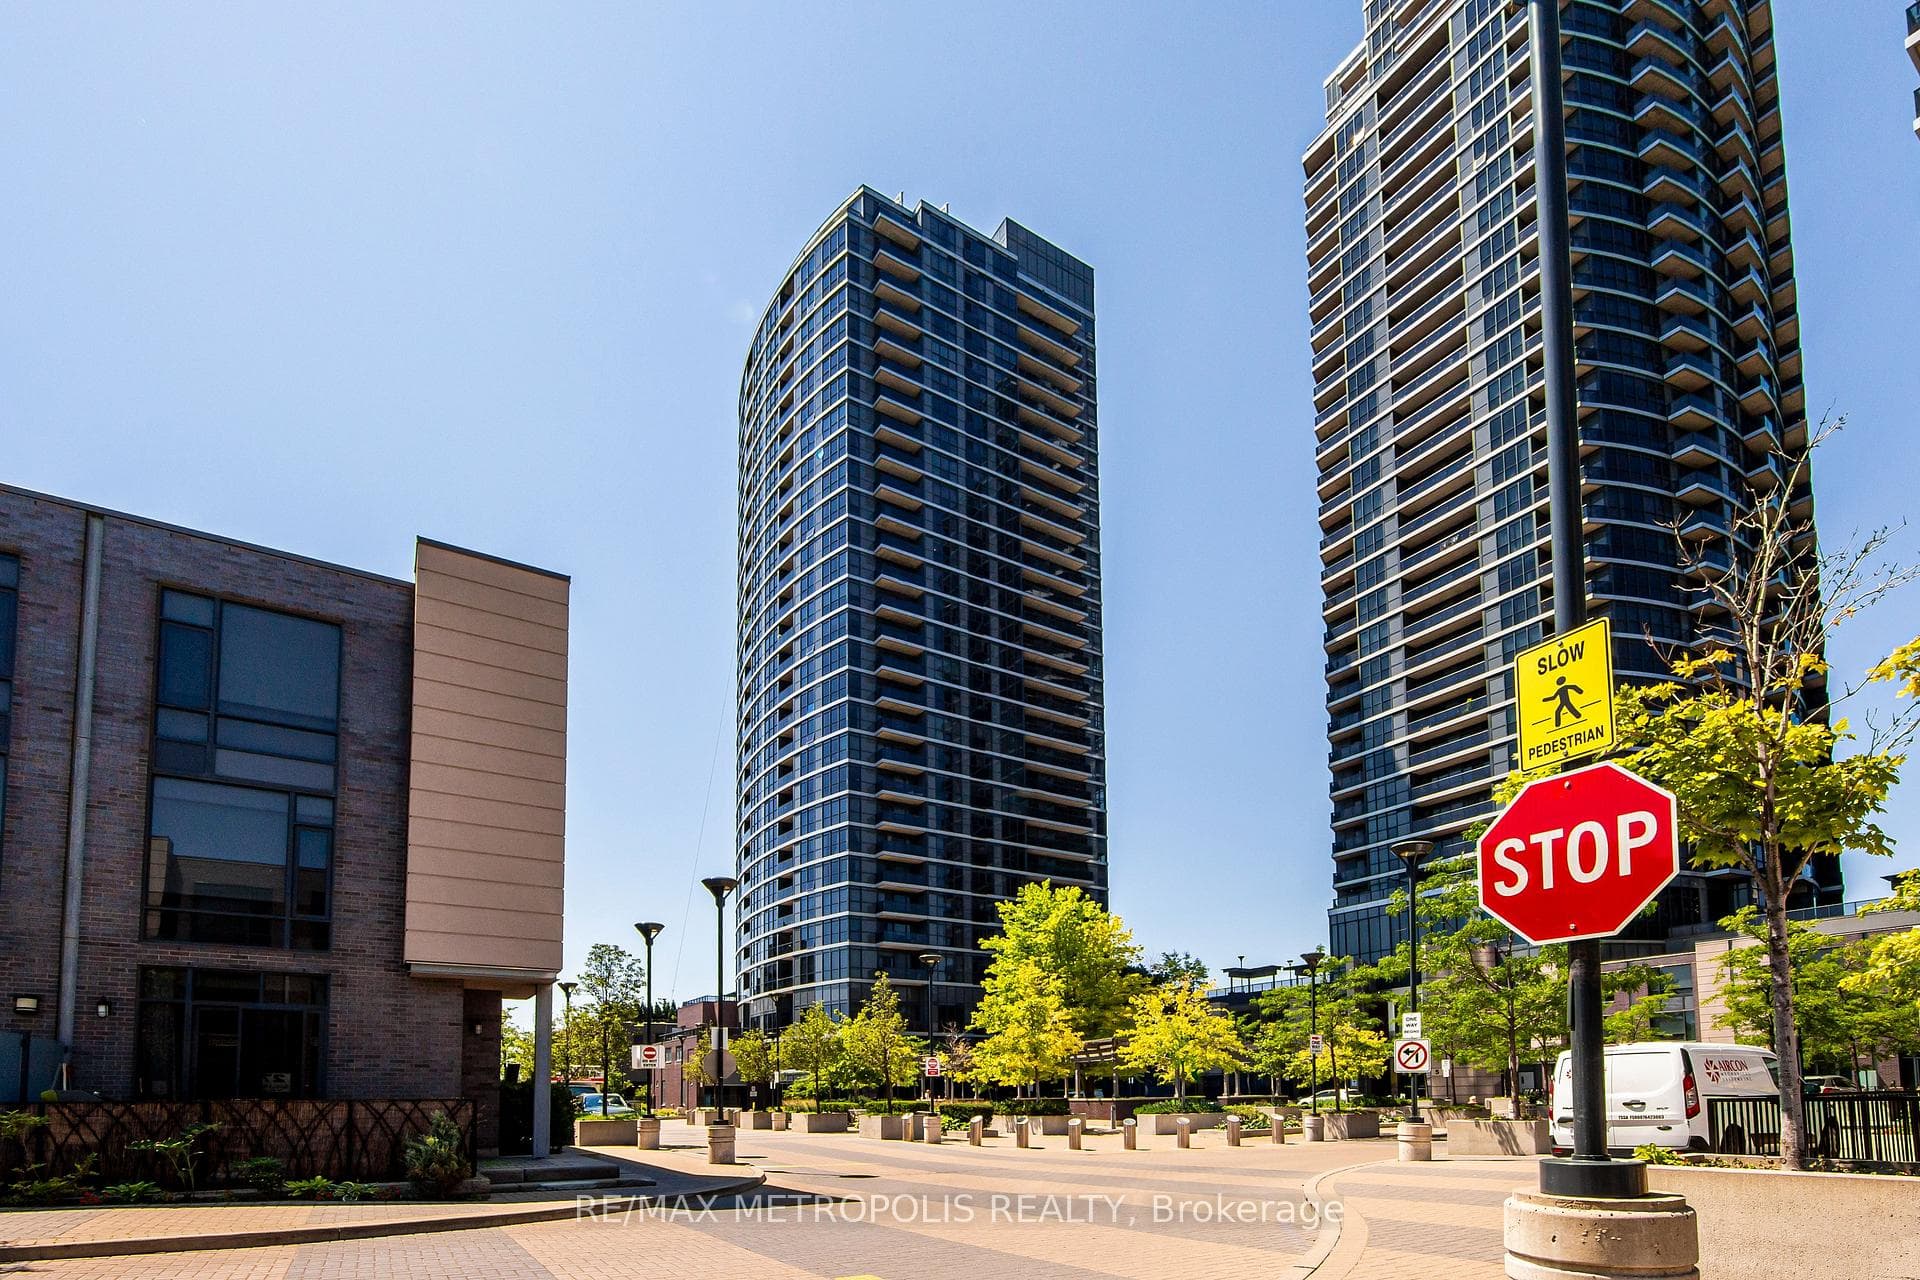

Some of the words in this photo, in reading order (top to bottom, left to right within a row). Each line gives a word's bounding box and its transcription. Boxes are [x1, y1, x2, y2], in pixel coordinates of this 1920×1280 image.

[1537, 640, 1585, 675] SLOW
[1528, 725, 1604, 760] PEDESTRIAN
[1493, 810, 1658, 897] STOP
[1718, 1060, 1748, 1071] AIRCON
